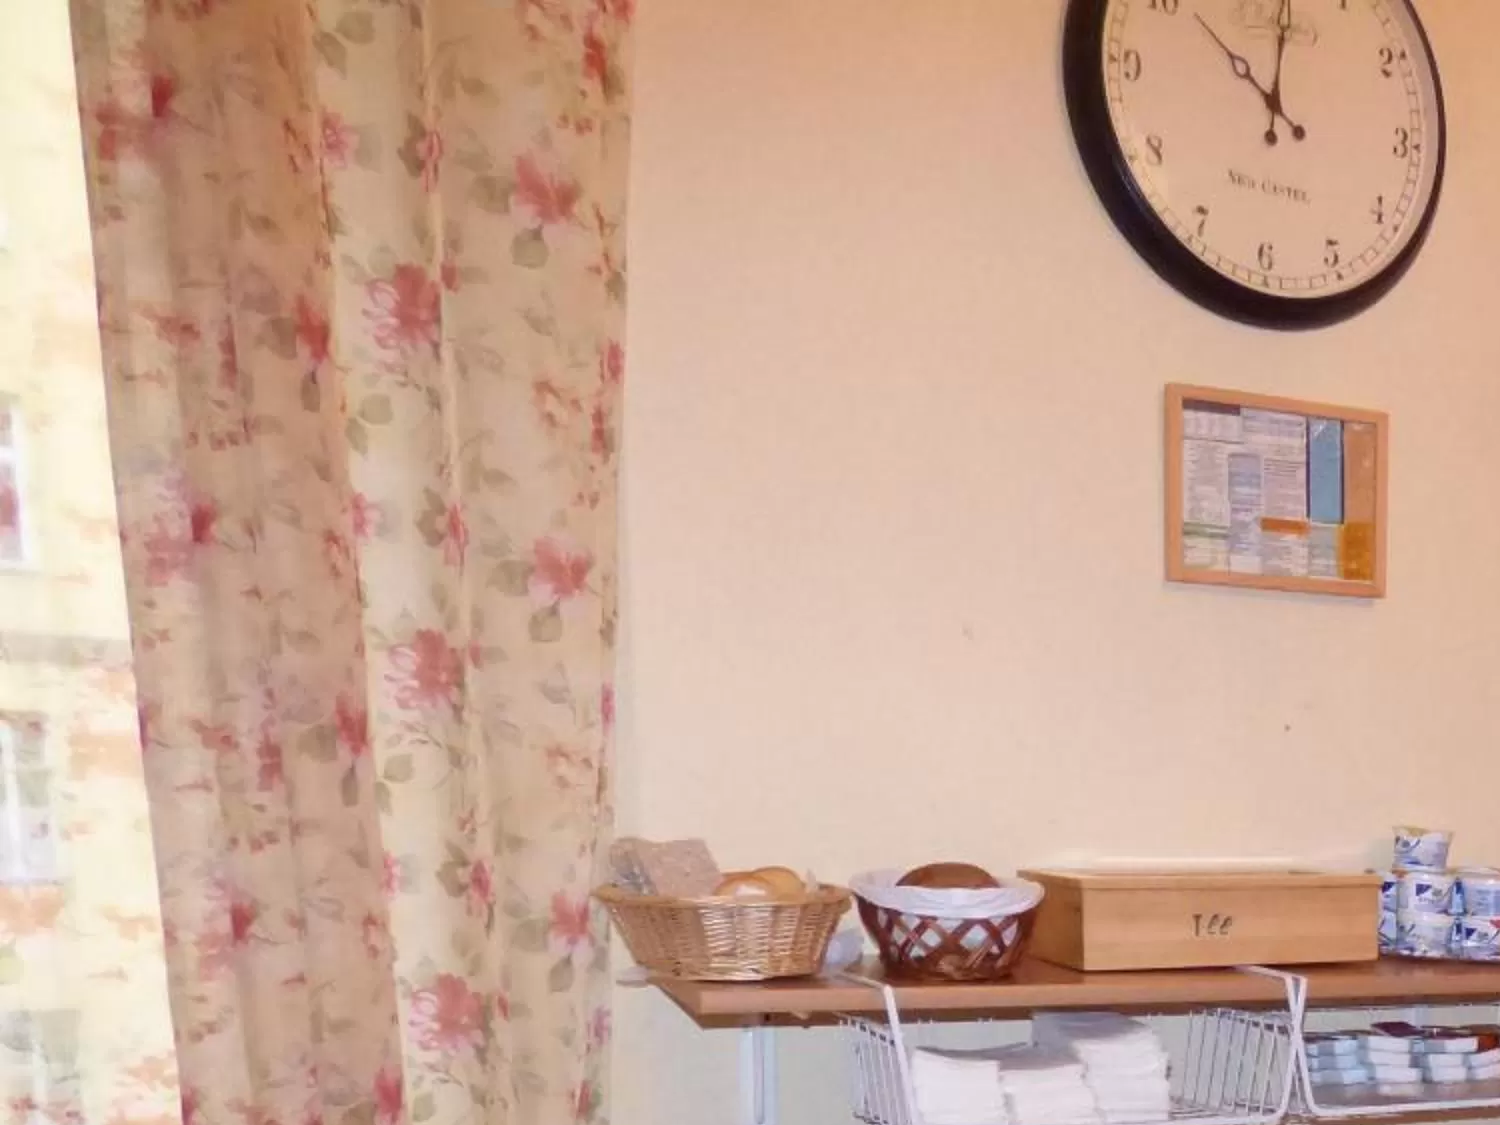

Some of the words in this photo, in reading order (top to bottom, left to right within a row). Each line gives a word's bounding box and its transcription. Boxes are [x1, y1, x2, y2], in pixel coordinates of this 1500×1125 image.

[1123, 49, 1142, 81] 9
[1379, 47, 1393, 78] 2
[1145, 135, 1164, 166] 8
[1393, 127, 1409, 158] 3
[1193, 205, 1209, 238] 7
[1370, 195, 1384, 225] 4
[1257, 242, 1274, 271] 6
[1323, 239, 1340, 268] 5
